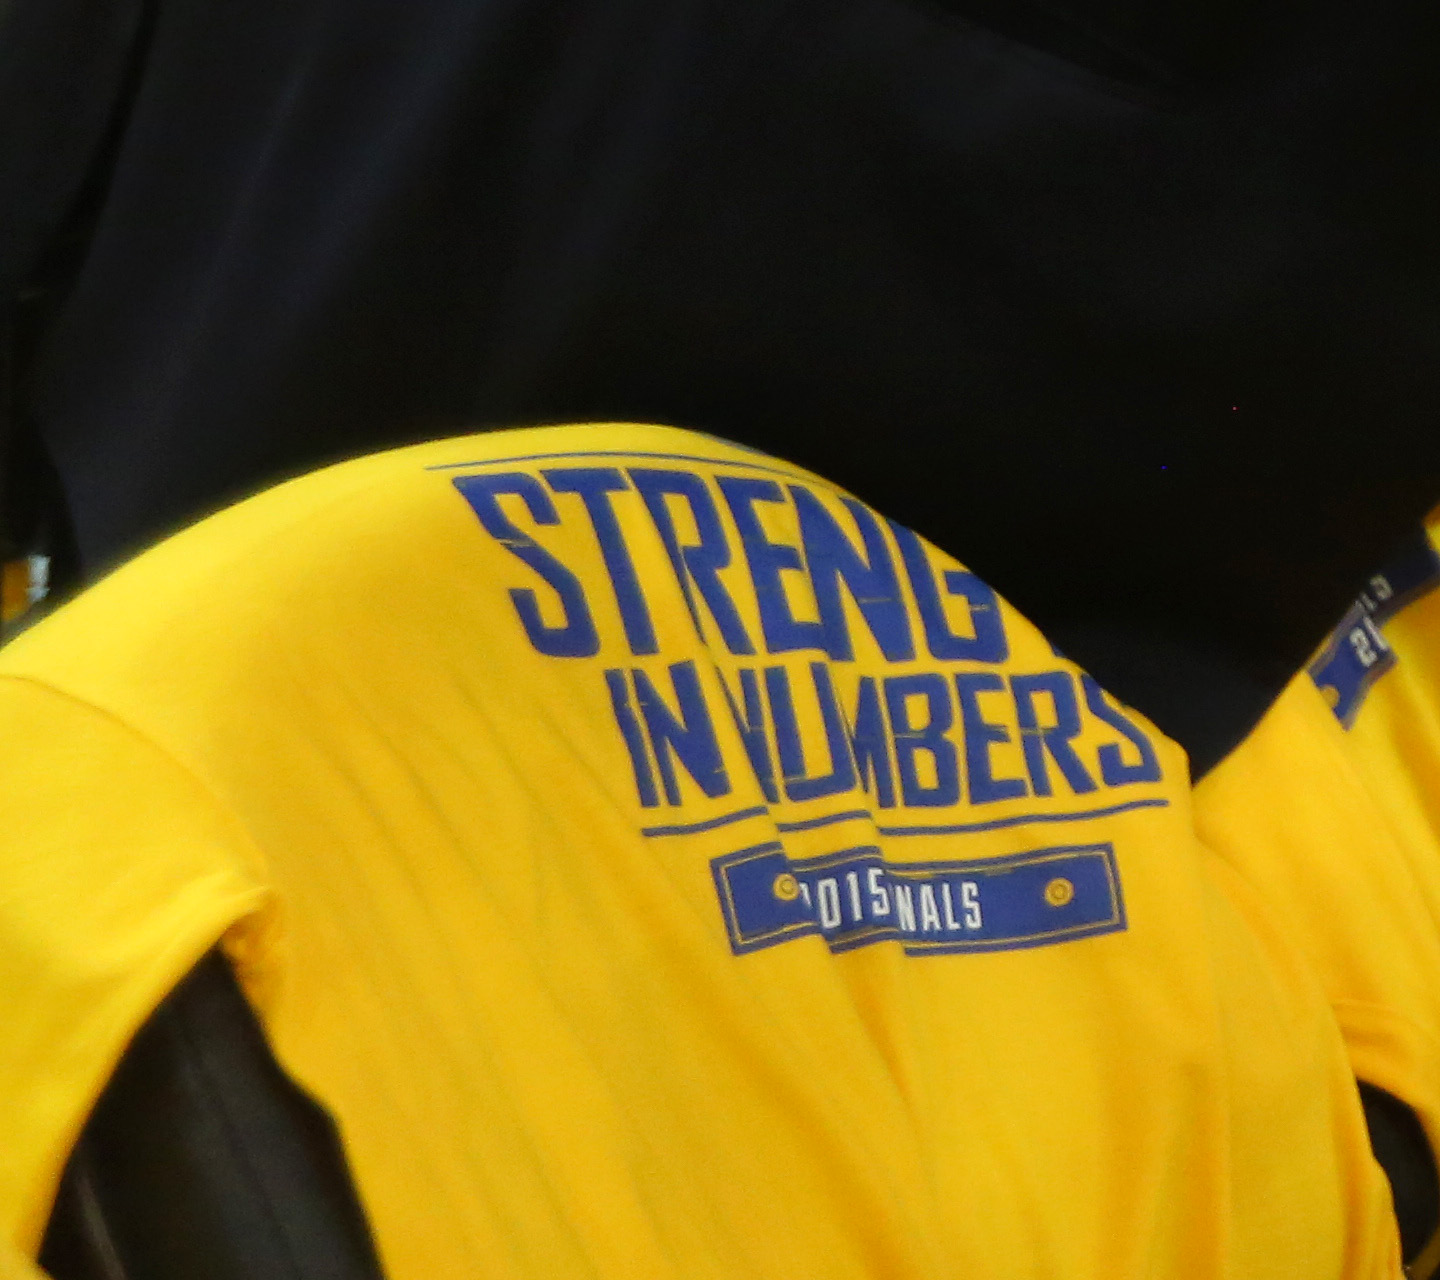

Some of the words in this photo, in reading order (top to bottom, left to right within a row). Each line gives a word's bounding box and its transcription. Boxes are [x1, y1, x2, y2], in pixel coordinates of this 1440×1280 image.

[452, 466, 1010, 664] STRENG
[798, 867, 891, 929] 015
[892, 878, 984, 931] NALS
